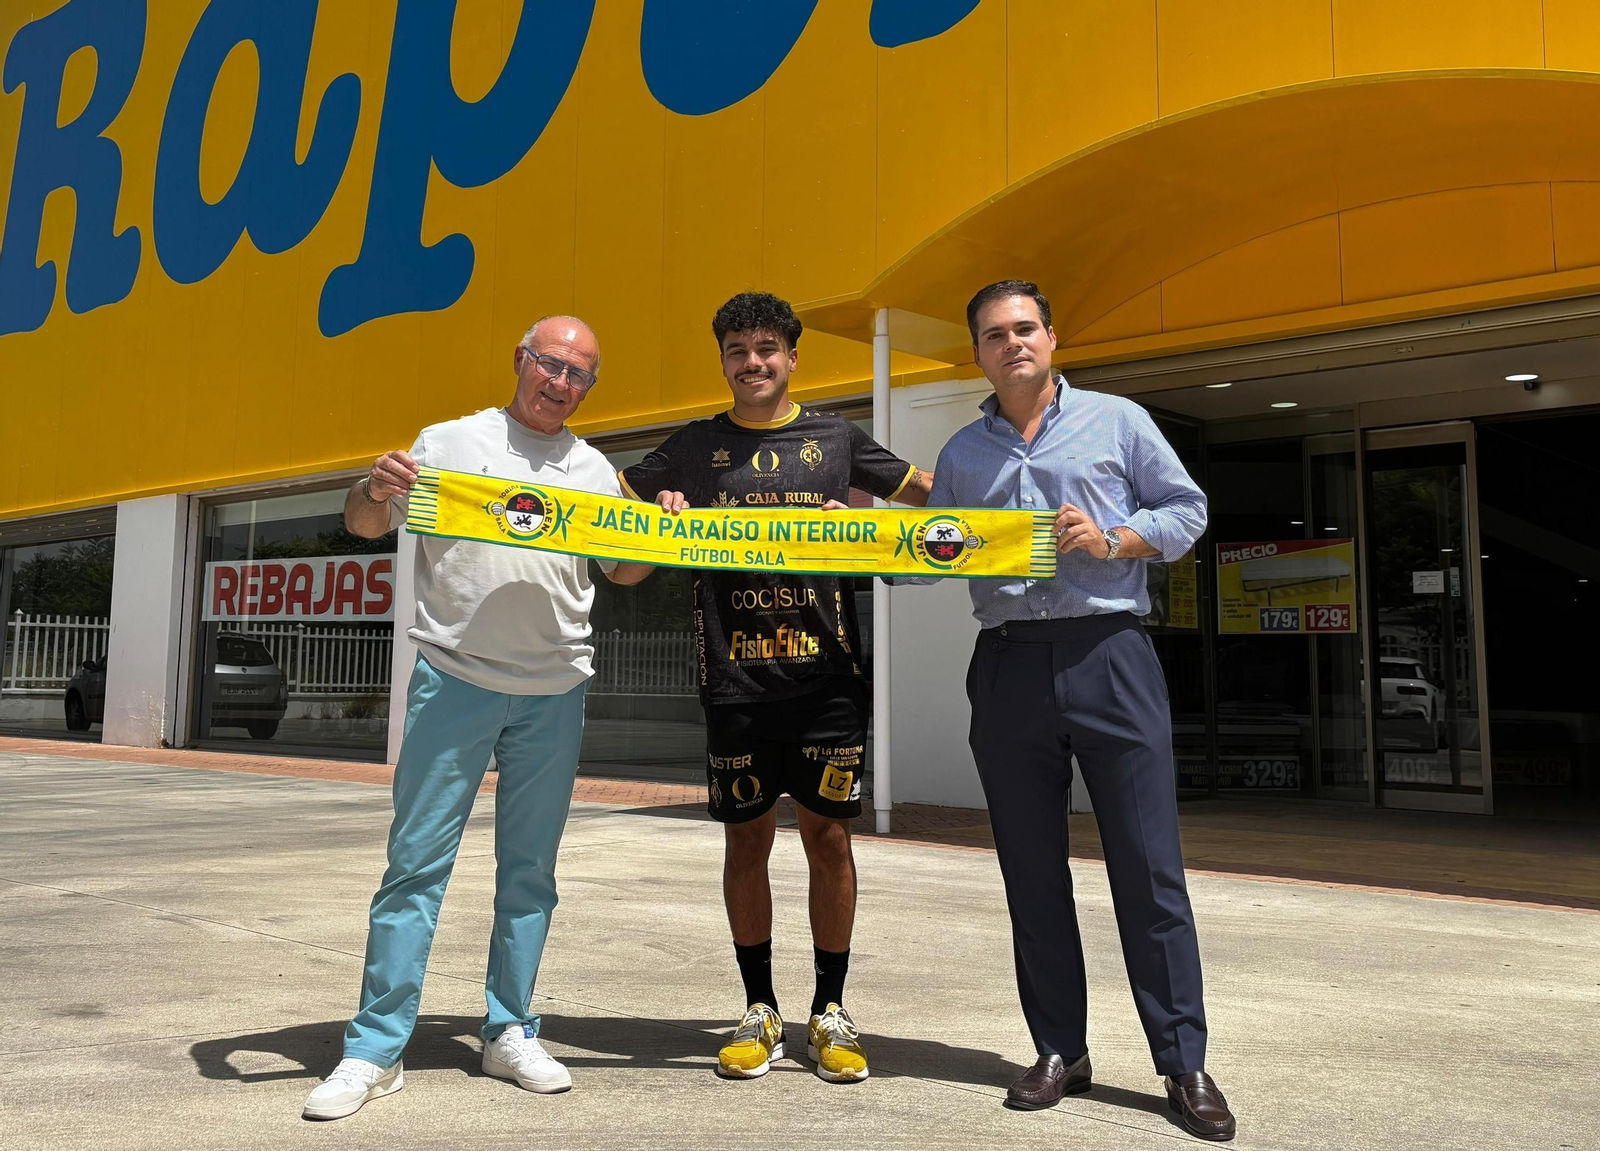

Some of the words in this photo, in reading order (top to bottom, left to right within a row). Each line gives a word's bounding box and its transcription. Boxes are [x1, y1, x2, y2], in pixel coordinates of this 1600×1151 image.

[745, 492, 780, 505] CAJA
[784, 491, 826, 505] RURAL
[495, 517, 506, 533] SALA
[541, 500, 553, 532] JAEN
[590, 504, 649, 535] JAÉN
[658, 514, 760, 541] PARAÍSO
[768, 520, 877, 543] INTERIOR
[961, 520, 973, 535] SALA
[916, 525, 926, 557] JAEN
[680, 545, 739, 564] FÚTBOL
[744, 550, 786, 566] SALA
[1220, 543, 1278, 563] PRECIO
[212, 559, 393, 615] REBAJAS
[696, 609, 708, 686] DIPUTACIÓN
[779, 656, 817, 665] AVANZADA
[827, 773, 848, 791] LZ
